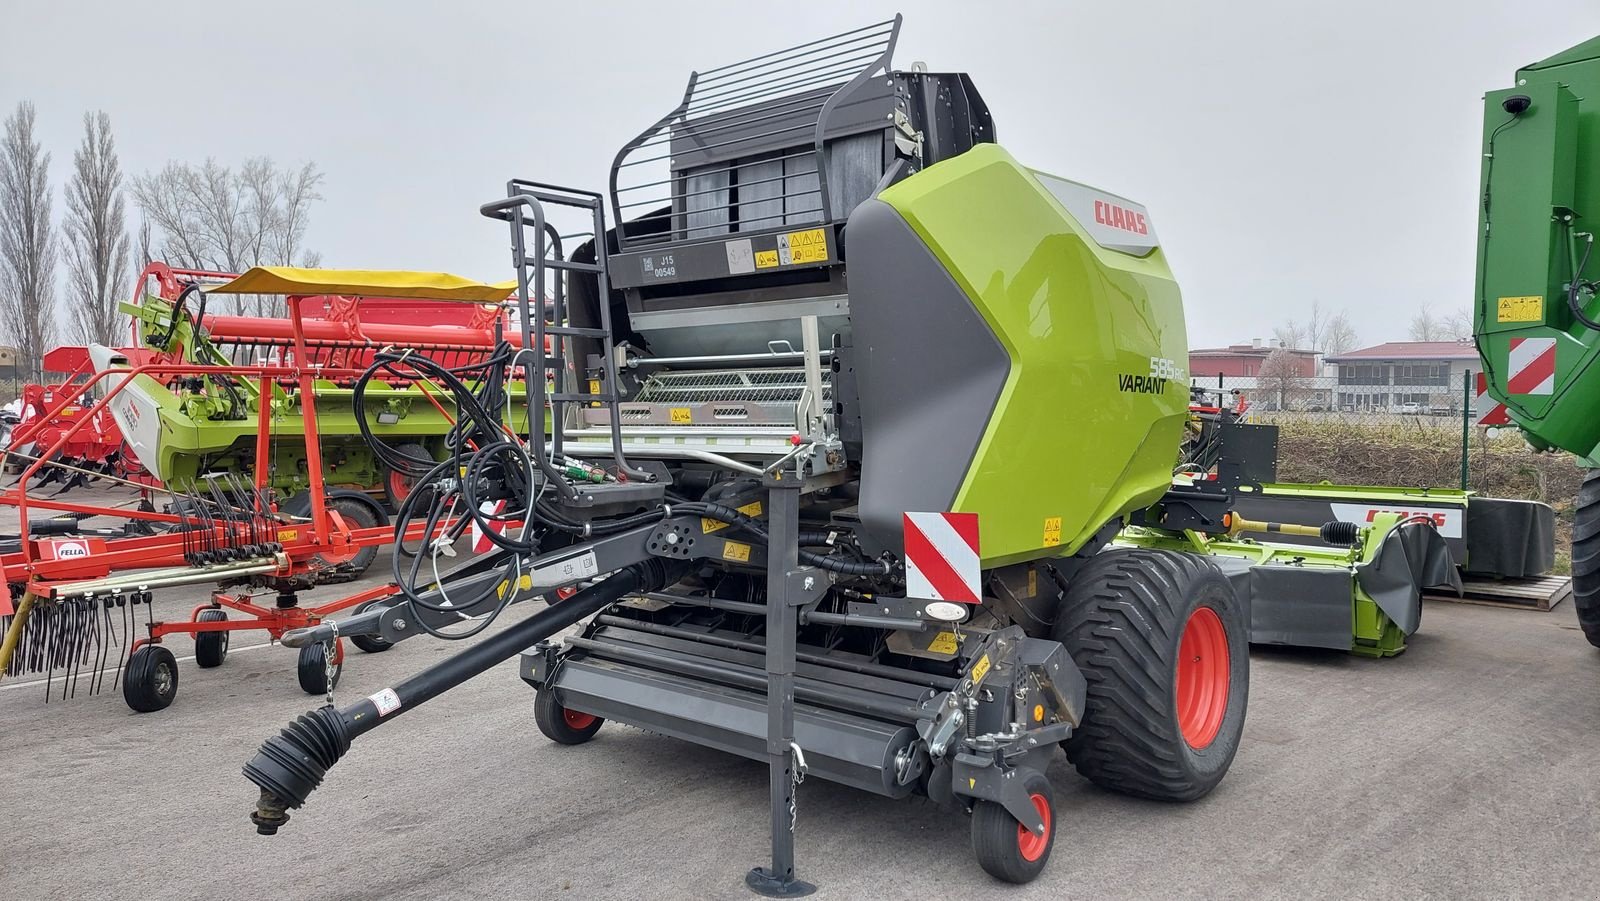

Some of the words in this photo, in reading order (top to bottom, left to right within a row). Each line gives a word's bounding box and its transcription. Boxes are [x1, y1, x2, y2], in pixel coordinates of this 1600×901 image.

[1094, 200, 1148, 235] CLAAS
[661, 256, 674, 266] J15
[654, 266, 676, 277] 00549
[1119, 374, 1166, 395] VARIANT
